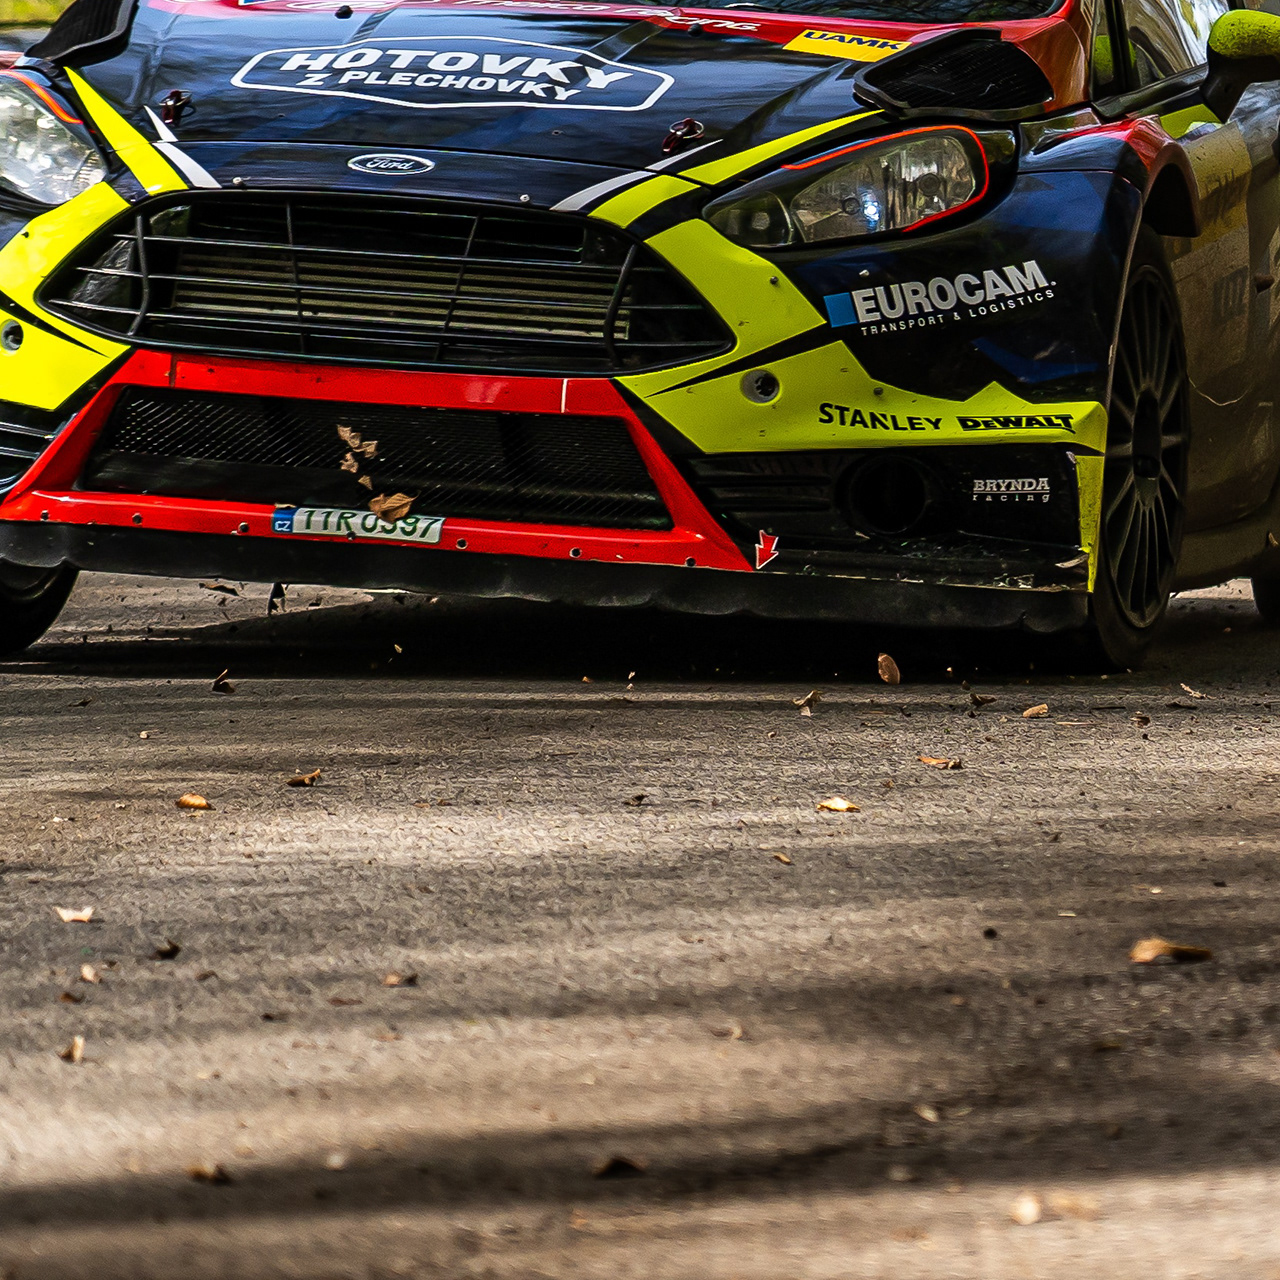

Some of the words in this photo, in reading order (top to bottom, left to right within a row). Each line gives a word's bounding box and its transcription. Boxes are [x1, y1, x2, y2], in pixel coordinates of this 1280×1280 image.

[803, 31, 902, 50] UAMK
[280, 48, 633, 89] HOTOVKY
[295, 72, 332, 87] Z
[339, 70, 581, 100] PLECHOVKY
[851, 260, 1049, 323] EUROCAM
[861, 314, 944, 336] TRANSPORT
[953, 312, 962, 321] &
[969, 289, 1055, 318] LOGISTICS
[818, 402, 943, 431] STANLEY
[972, 493, 1050, 503] racing
[973, 477, 1050, 491] BRYNDA
[274, 520, 291, 532] CZ
